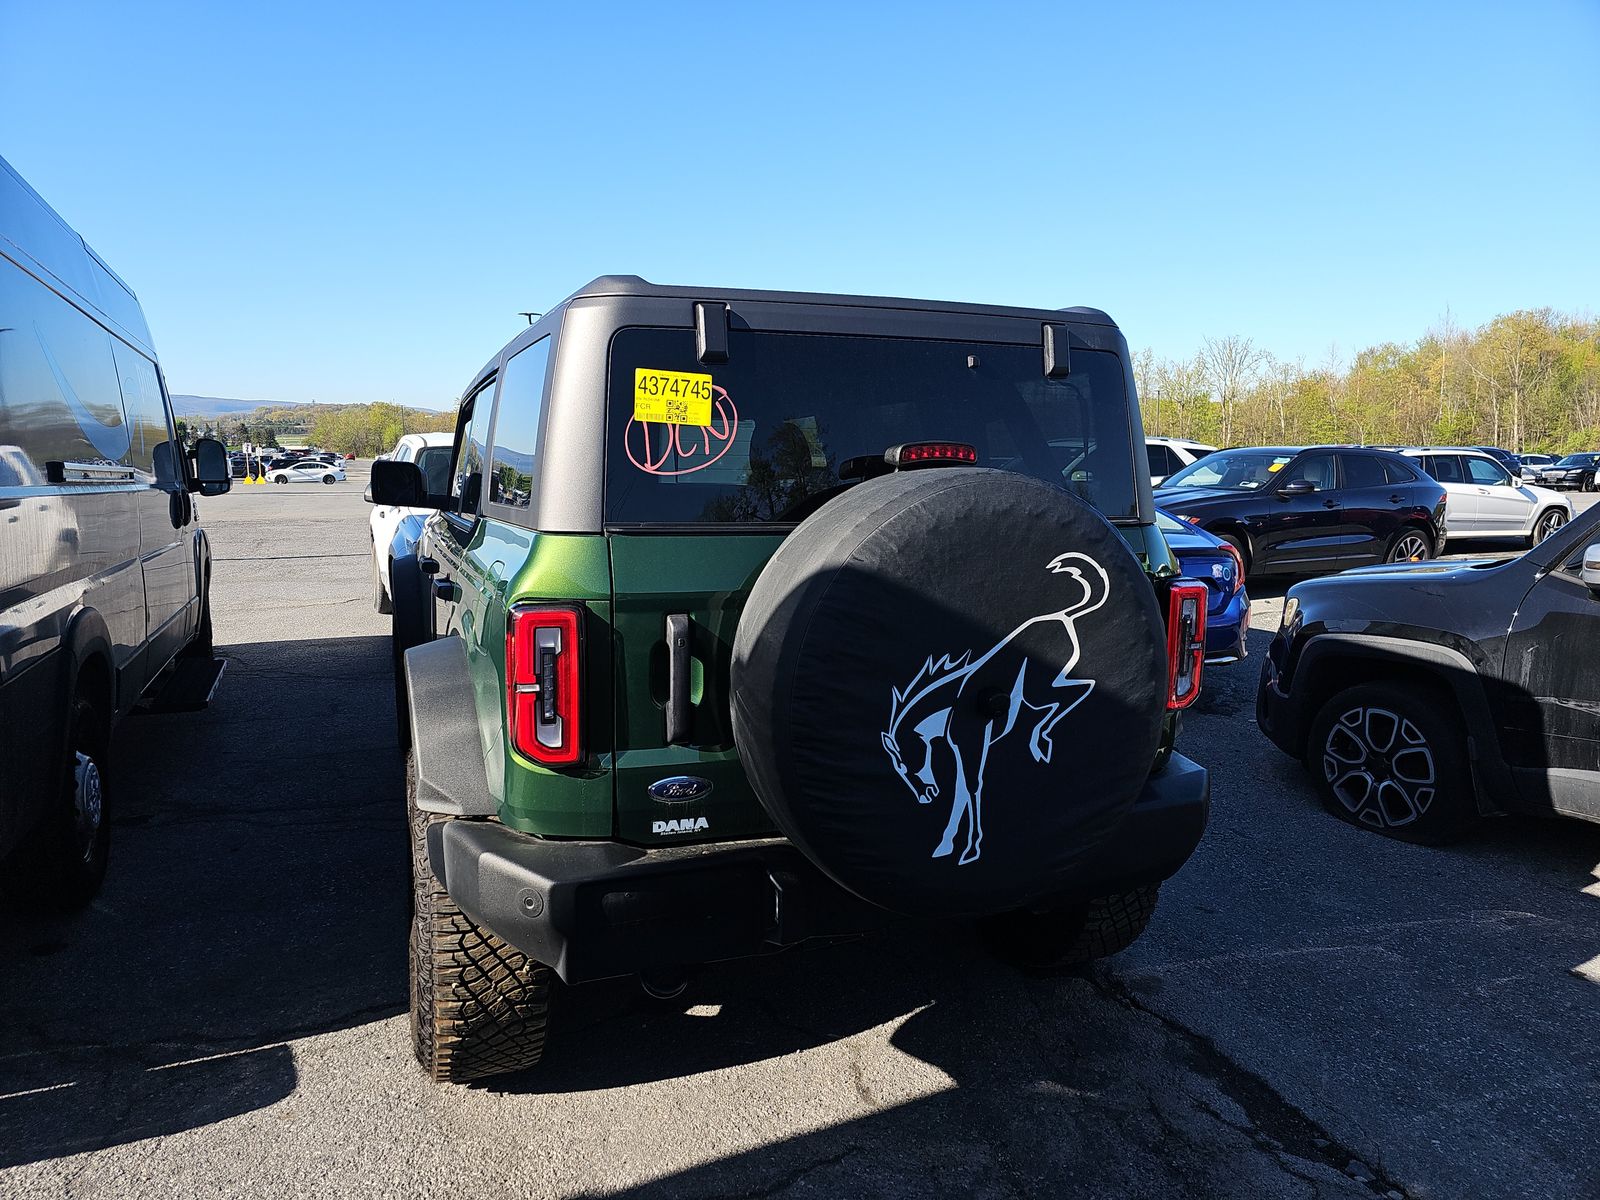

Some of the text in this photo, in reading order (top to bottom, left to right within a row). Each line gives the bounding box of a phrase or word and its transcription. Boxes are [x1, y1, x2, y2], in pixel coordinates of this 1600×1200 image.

[638, 375, 711, 400] 4374745
[636, 402, 651, 410] FCR
[664, 782, 697, 796] Ford
[652, 817, 709, 833] DANA
